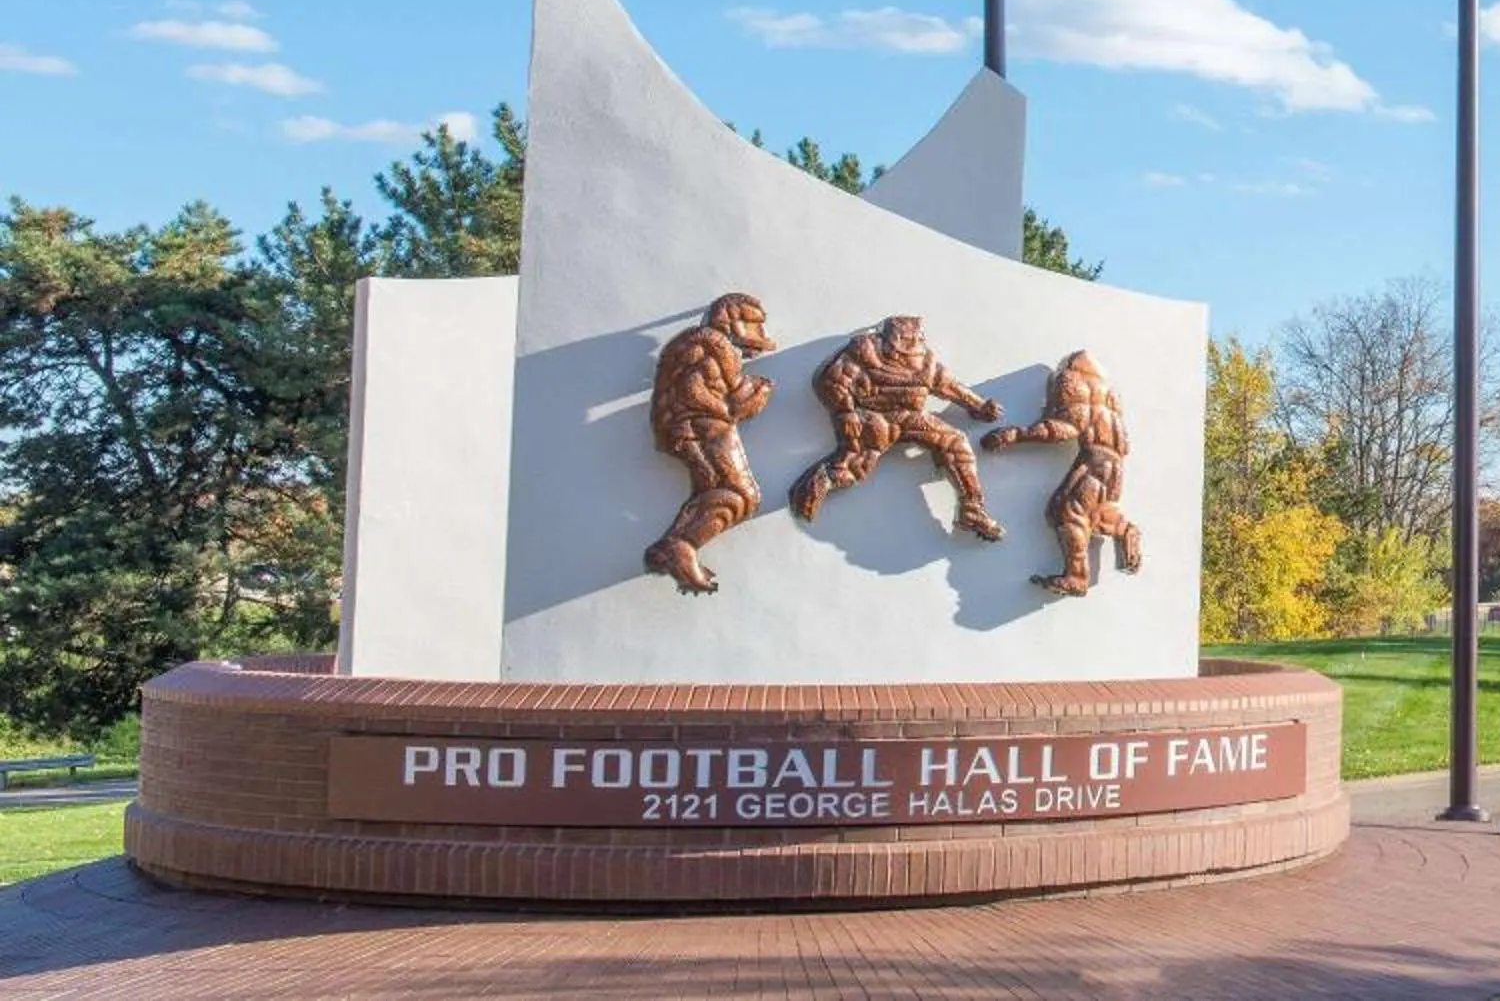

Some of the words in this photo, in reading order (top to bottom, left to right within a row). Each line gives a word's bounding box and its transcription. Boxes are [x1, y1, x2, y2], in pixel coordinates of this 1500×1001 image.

[404, 745, 527, 787] PRO
[551, 747, 893, 789] FOOTBALL
[920, 743, 1068, 787] HALL
[1089, 740, 1149, 780] OF
[1167, 734, 1268, 776] FAME
[642, 794, 718, 819] 2121
[735, 792, 890, 820] GEORGE
[908, 788, 1017, 816] HALAS
[1035, 784, 1121, 812] DRIVE
